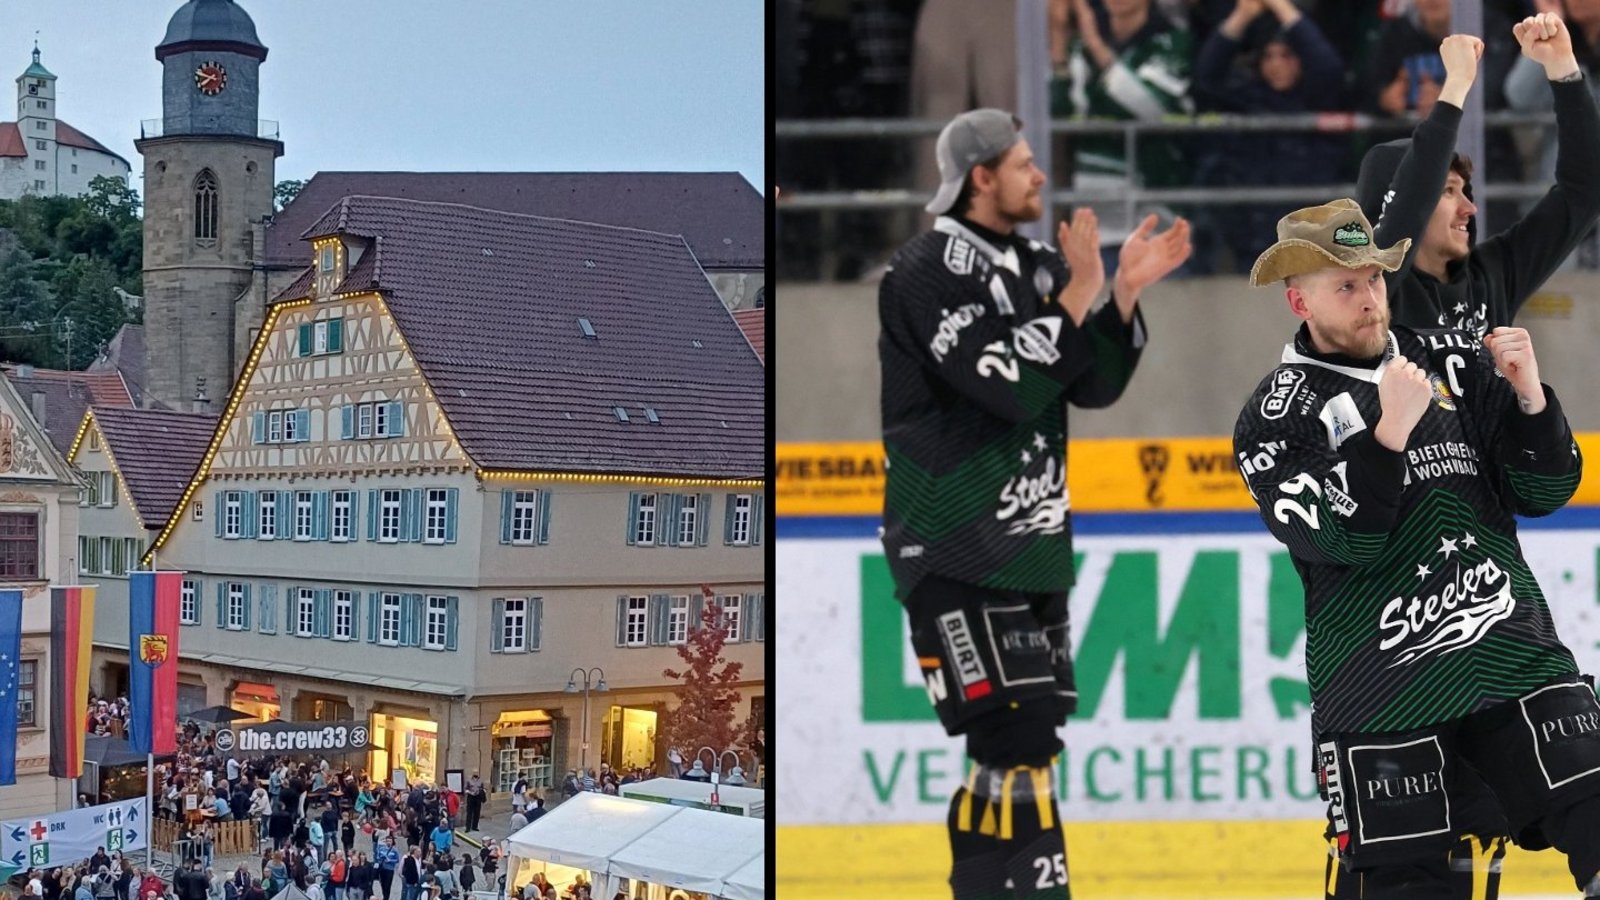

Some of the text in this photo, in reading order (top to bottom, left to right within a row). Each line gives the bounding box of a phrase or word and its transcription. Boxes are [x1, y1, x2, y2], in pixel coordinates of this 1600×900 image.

[1445, 354, 1465, 397] C
[1274, 472, 1322, 531] 29
[1380, 557, 1502, 650] Steelers
[946, 618, 981, 676] BURT
[239, 726, 347, 750] the.crew33
[1367, 772, 1438, 800] PURE
[51, 821, 66, 832] DRK
[93, 815, 104, 825] WC
[1033, 853, 1068, 889] 25
